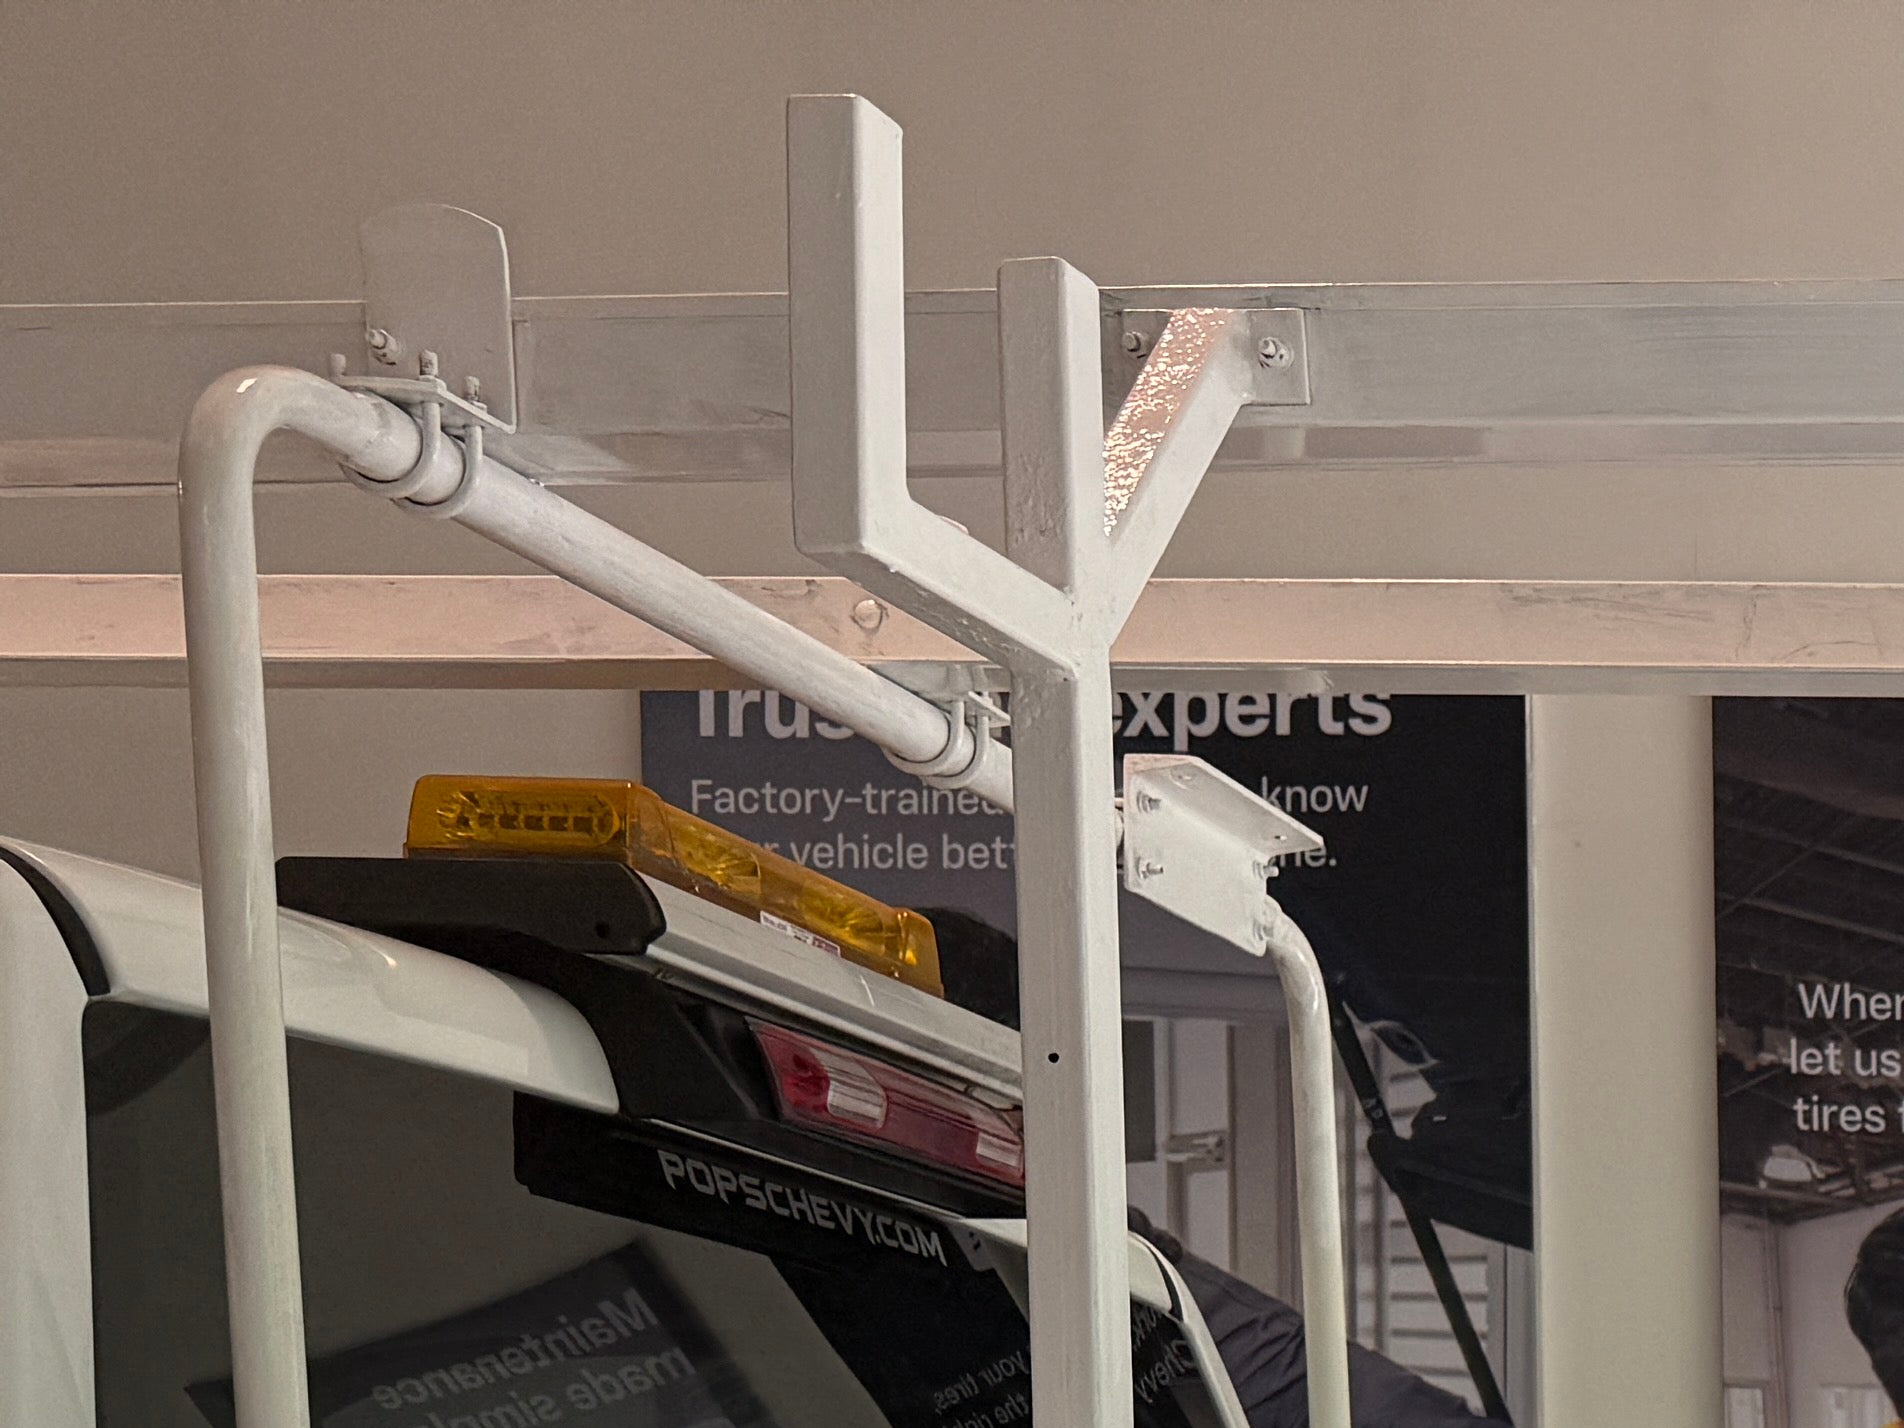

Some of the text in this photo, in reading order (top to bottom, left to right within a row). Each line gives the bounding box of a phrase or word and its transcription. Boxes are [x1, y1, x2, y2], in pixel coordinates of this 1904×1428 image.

[1262, 775, 1369, 813] know
[790, 833, 928, 869] vehicle
[1789, 1037, 1844, 1075] let
[1855, 1049, 1901, 1079] us
[1793, 1095, 1885, 1132] tires
[657, 1149, 948, 1268] POPSCHEVY.COM
